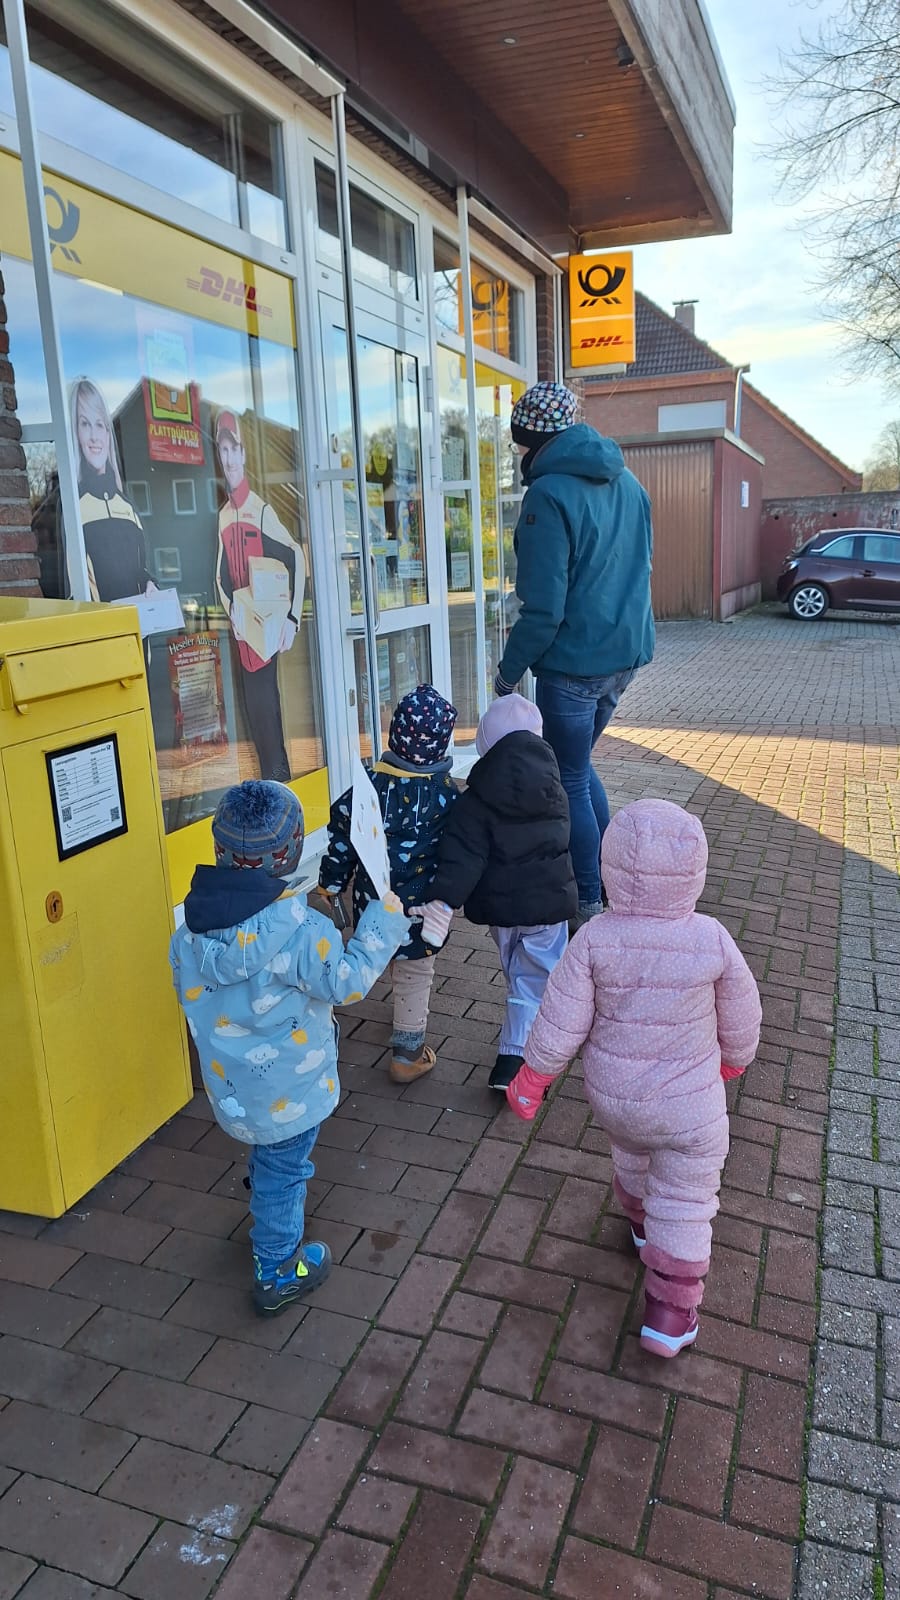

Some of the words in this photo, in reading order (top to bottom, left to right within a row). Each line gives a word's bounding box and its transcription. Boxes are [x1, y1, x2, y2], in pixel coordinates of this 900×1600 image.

[199, 266, 262, 314] DHL
[580, 335, 624, 349] DHL
[196, 634, 218, 648] Advent
